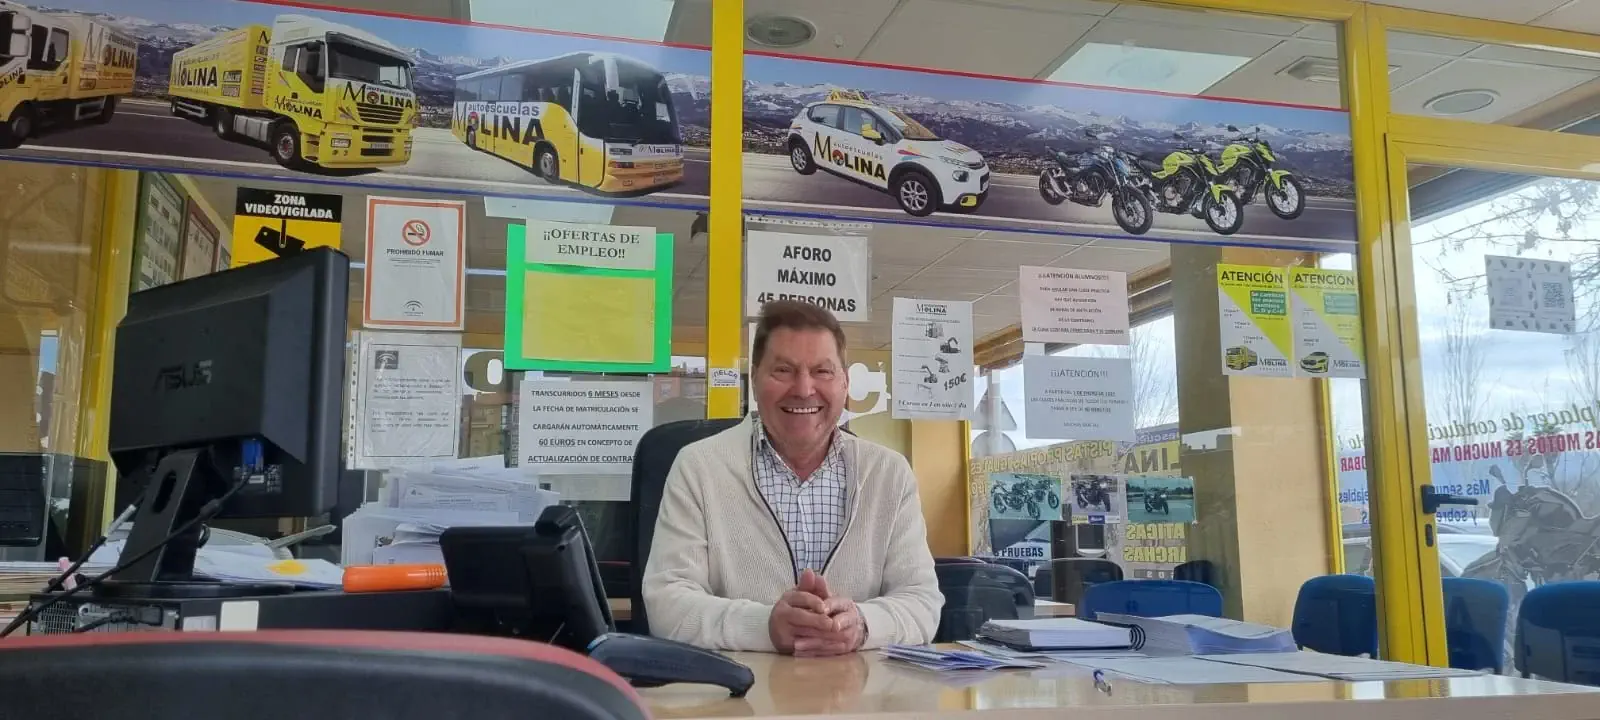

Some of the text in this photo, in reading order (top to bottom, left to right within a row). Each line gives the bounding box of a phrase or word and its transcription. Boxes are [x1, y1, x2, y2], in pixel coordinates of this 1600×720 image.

[343, 81, 413, 109] MOLINA
[275, 95, 323, 119] MOLINA
[468, 102, 540, 117] autoescuelas
[453, 102, 545, 145] MOLINA
[813, 131, 887, 182] MOLINA
[274, 194, 306, 206] ZONA
[244, 203, 334, 220] VIDEOVIGILADA
[543, 228, 641, 244] ¡¡OFERTAS DE
[386, 248, 444, 257] PROHIBIDO FUMAR
[557, 244, 626, 259] EMPLEO!!
[782, 245, 832, 262] AFORO
[777, 267, 837, 287] MÁXIMO
[1221, 270, 1284, 283] ATENCIÓN
[1294, 273, 1356, 286] ATENCIÓN
[916, 303, 948, 314] MOLINA
[154, 360, 213, 391] ASUS
[943, 373, 968, 391] 150€
[588, 390, 593, 398] 6
[594, 390, 619, 398] MESES
[575, 405, 630, 413] MATRICULACIÓN
[571, 423, 639, 431] AUTOMÁTICAMENTE
[528, 454, 588, 463] ACTUALIZACIÓN
[590, 455, 600, 463] DE
[1001, 547, 1044, 557] PRUEBAS
